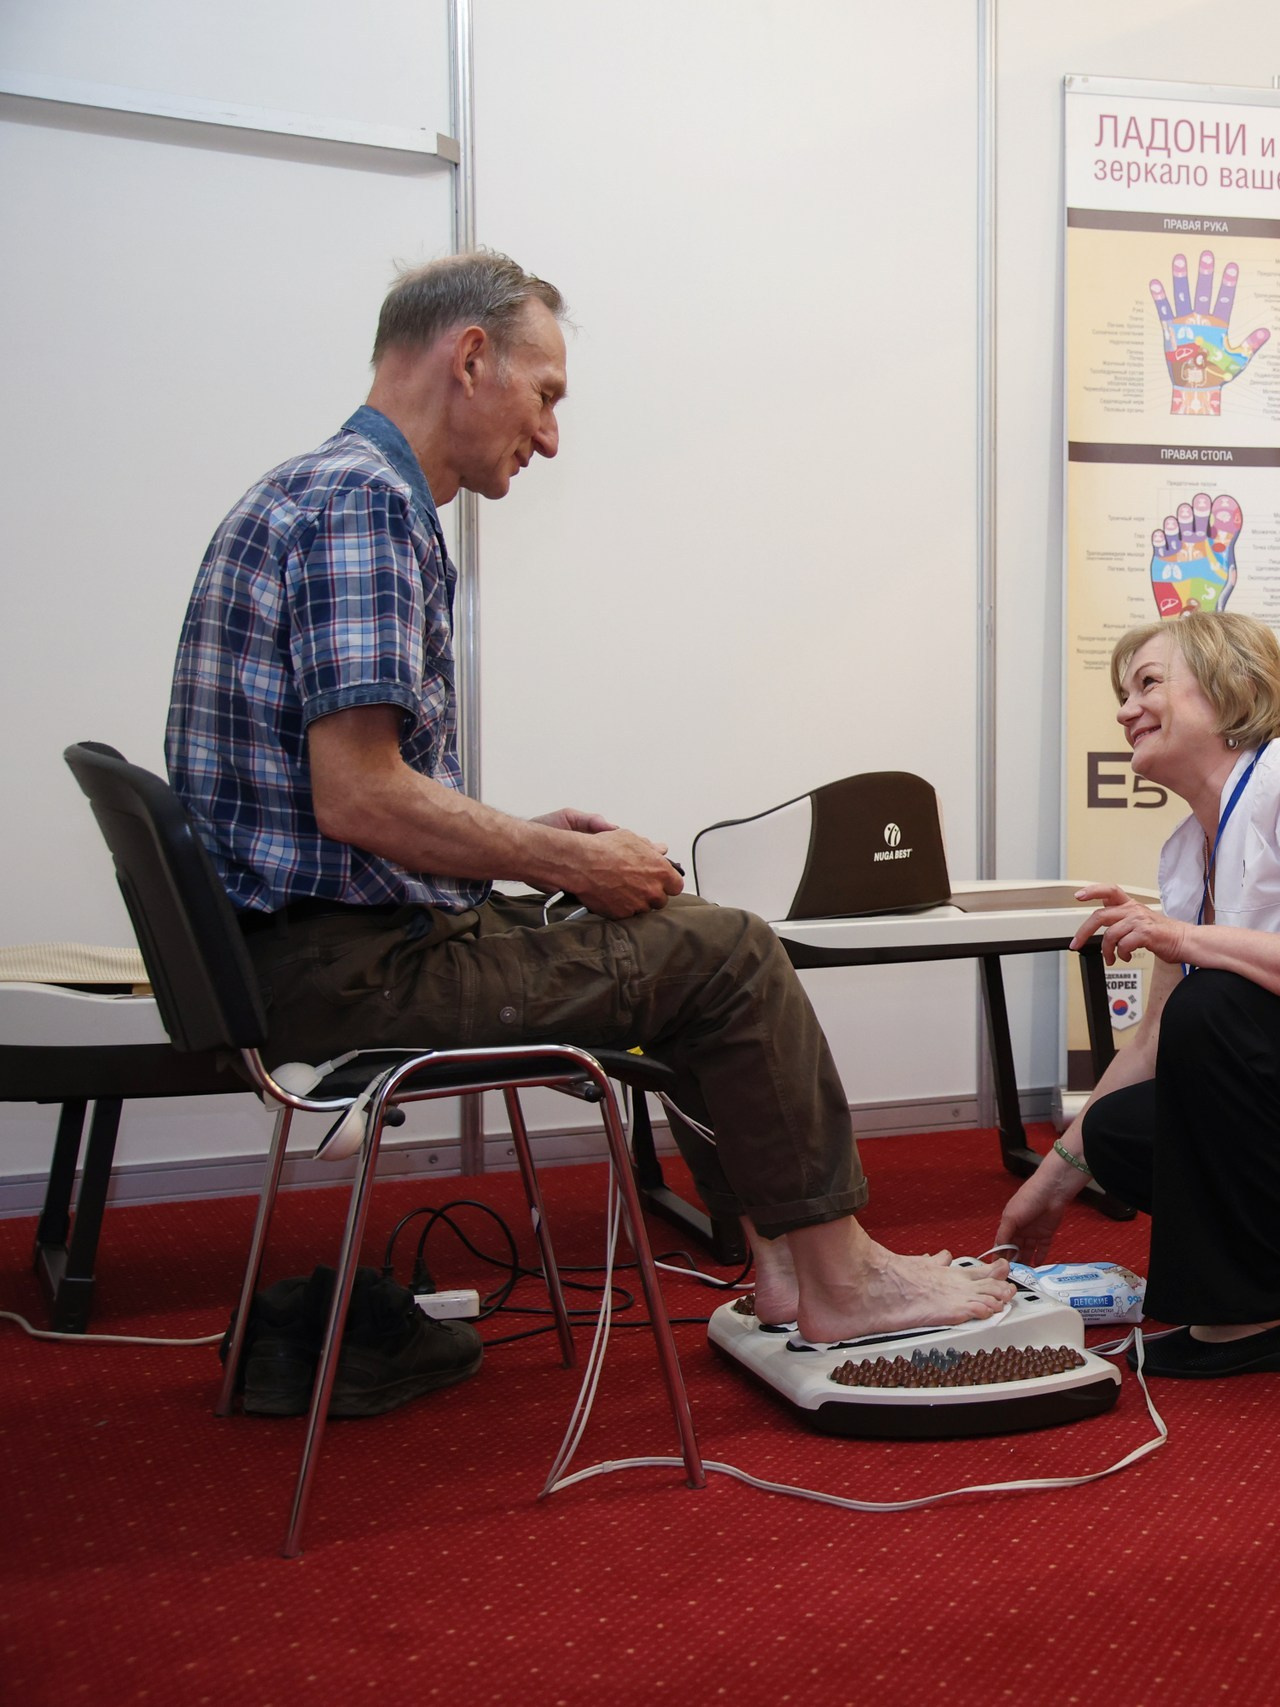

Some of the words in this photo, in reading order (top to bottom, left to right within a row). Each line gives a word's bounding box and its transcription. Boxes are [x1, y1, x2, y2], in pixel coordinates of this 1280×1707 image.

[1095, 113, 1246, 158] ЛАДОНИ
[1261, 137, 1275, 157] и
[1094, 159, 1208, 188] зеркало
[1164, 218, 1201, 231] ПРАВАЯ
[1204, 221, 1228, 233] РУКА
[1161, 448, 1198, 460] ПРАВАЯ
[1201, 450, 1233, 461] СТОПА
[1087, 752, 1168, 809] E5
[874, 851, 894, 862] NUGA
[895, 849, 911, 859] BEST
[1106, 981, 1137, 990] КОРЕЕ
[1074, 1297, 1108, 1306] ДЕТСКИЕ
